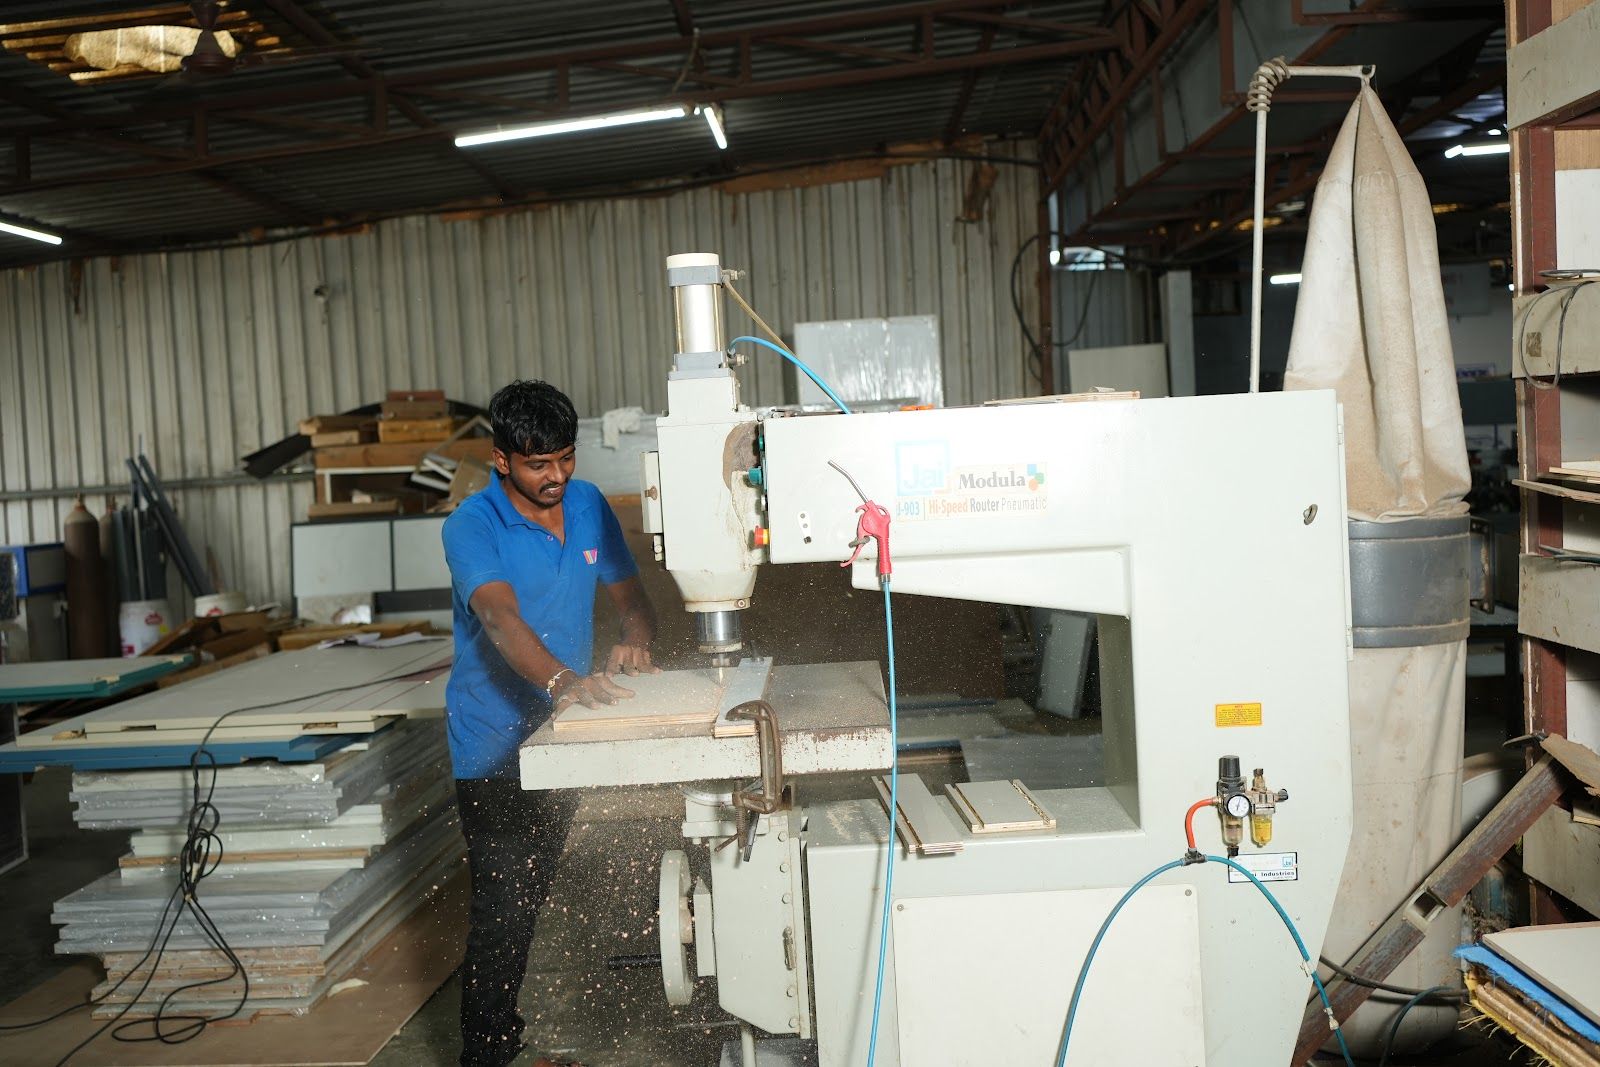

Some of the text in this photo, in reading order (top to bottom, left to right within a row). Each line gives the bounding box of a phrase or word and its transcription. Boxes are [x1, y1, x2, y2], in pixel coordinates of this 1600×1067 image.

[903, 460, 944, 489] Jai
[958, 471, 1026, 489] Modula
[929, 499, 968, 516] Hi-Speed
[970, 498, 999, 512] Router
[1001, 497, 1047, 511] Pneumatic
